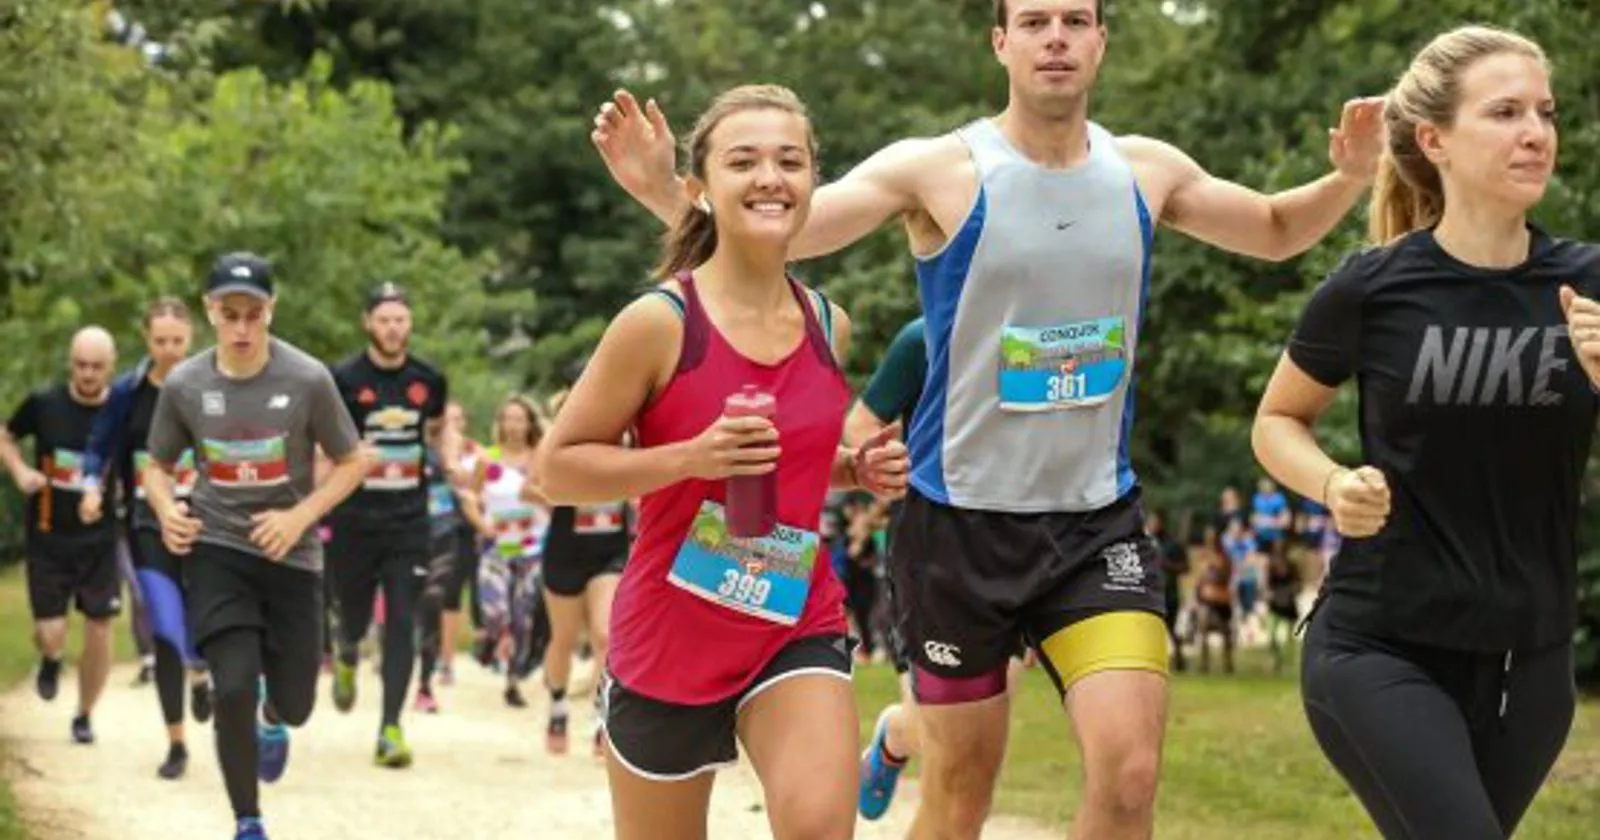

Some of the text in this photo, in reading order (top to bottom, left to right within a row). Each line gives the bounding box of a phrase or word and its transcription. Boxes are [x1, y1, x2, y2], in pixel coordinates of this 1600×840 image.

[1040, 324, 1099, 342] CONQUER
[1405, 324, 1569, 405] NIKE
[718, 568, 771, 604] 399
